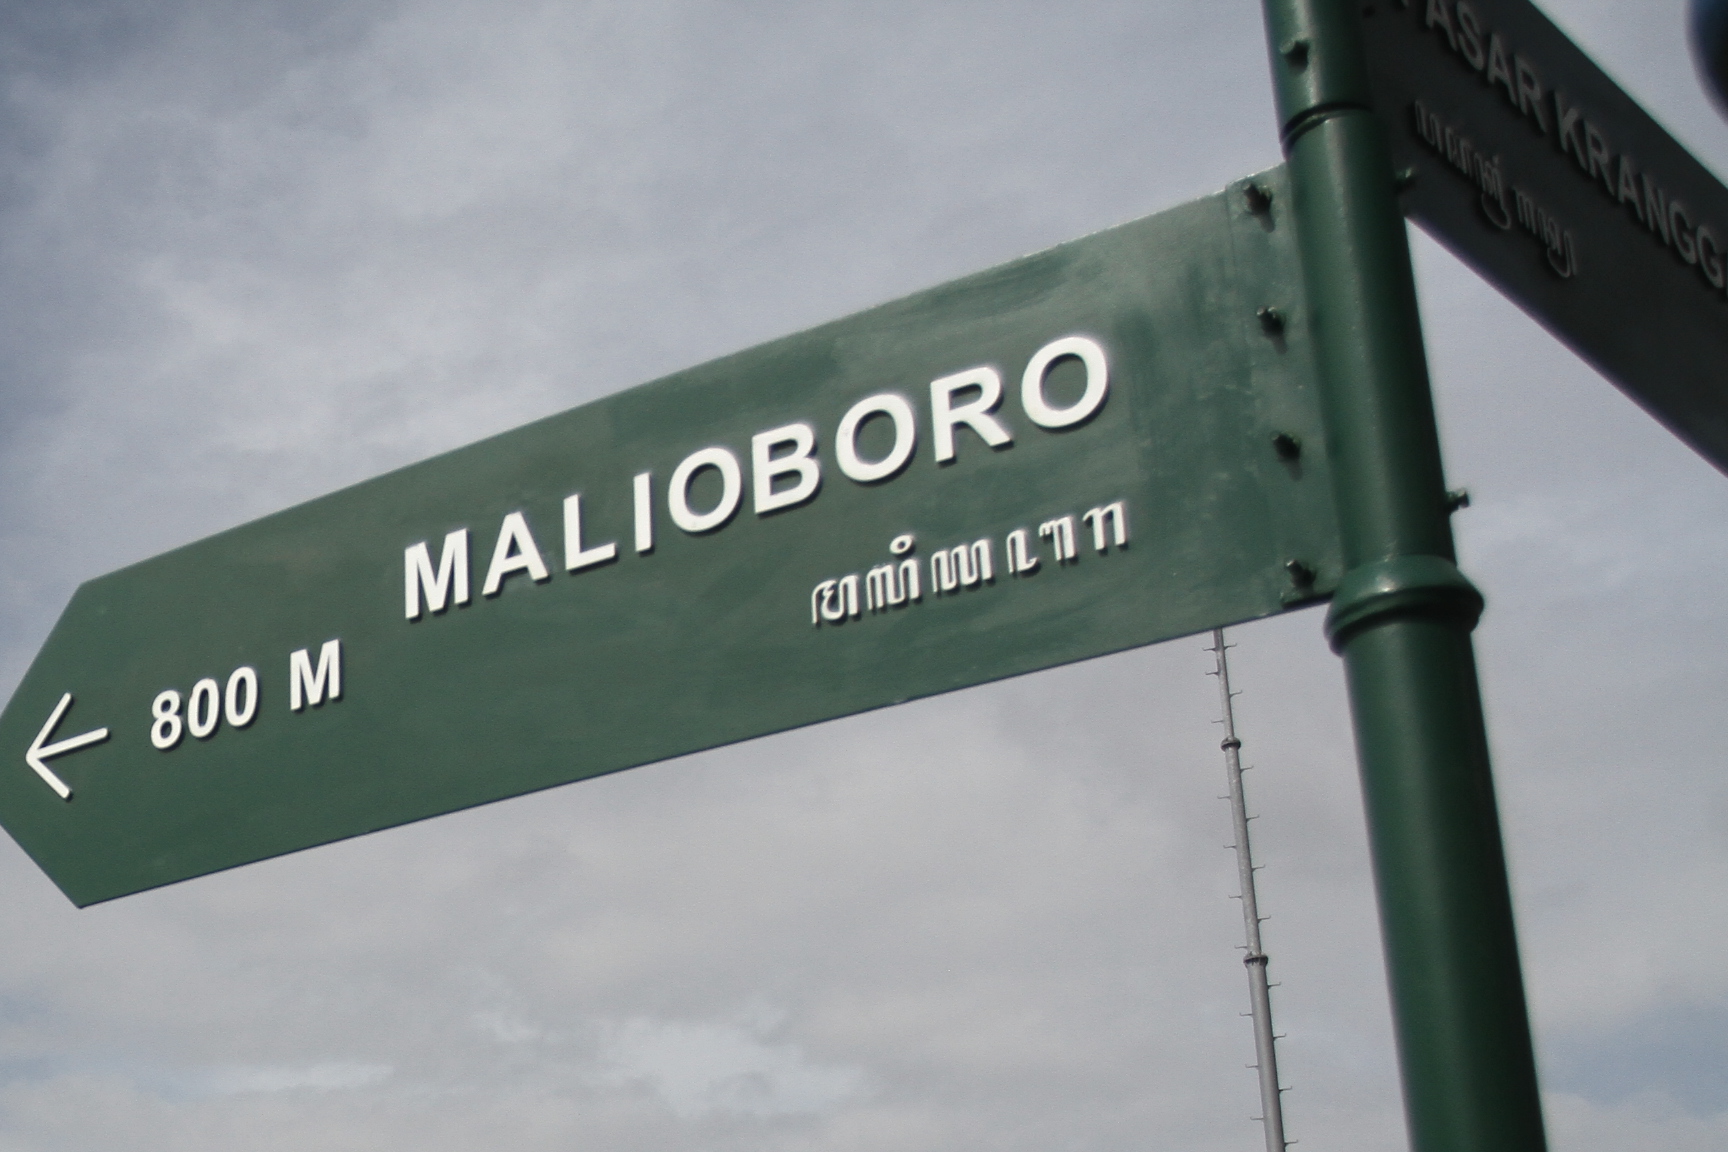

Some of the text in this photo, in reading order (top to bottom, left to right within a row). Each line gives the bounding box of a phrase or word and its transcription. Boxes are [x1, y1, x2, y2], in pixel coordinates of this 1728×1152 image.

[1400, 0, 1728, 291] ASAR KRANGG
[404, 335, 1109, 620] MALIOBORO
[150, 638, 340, 749] 800 M
